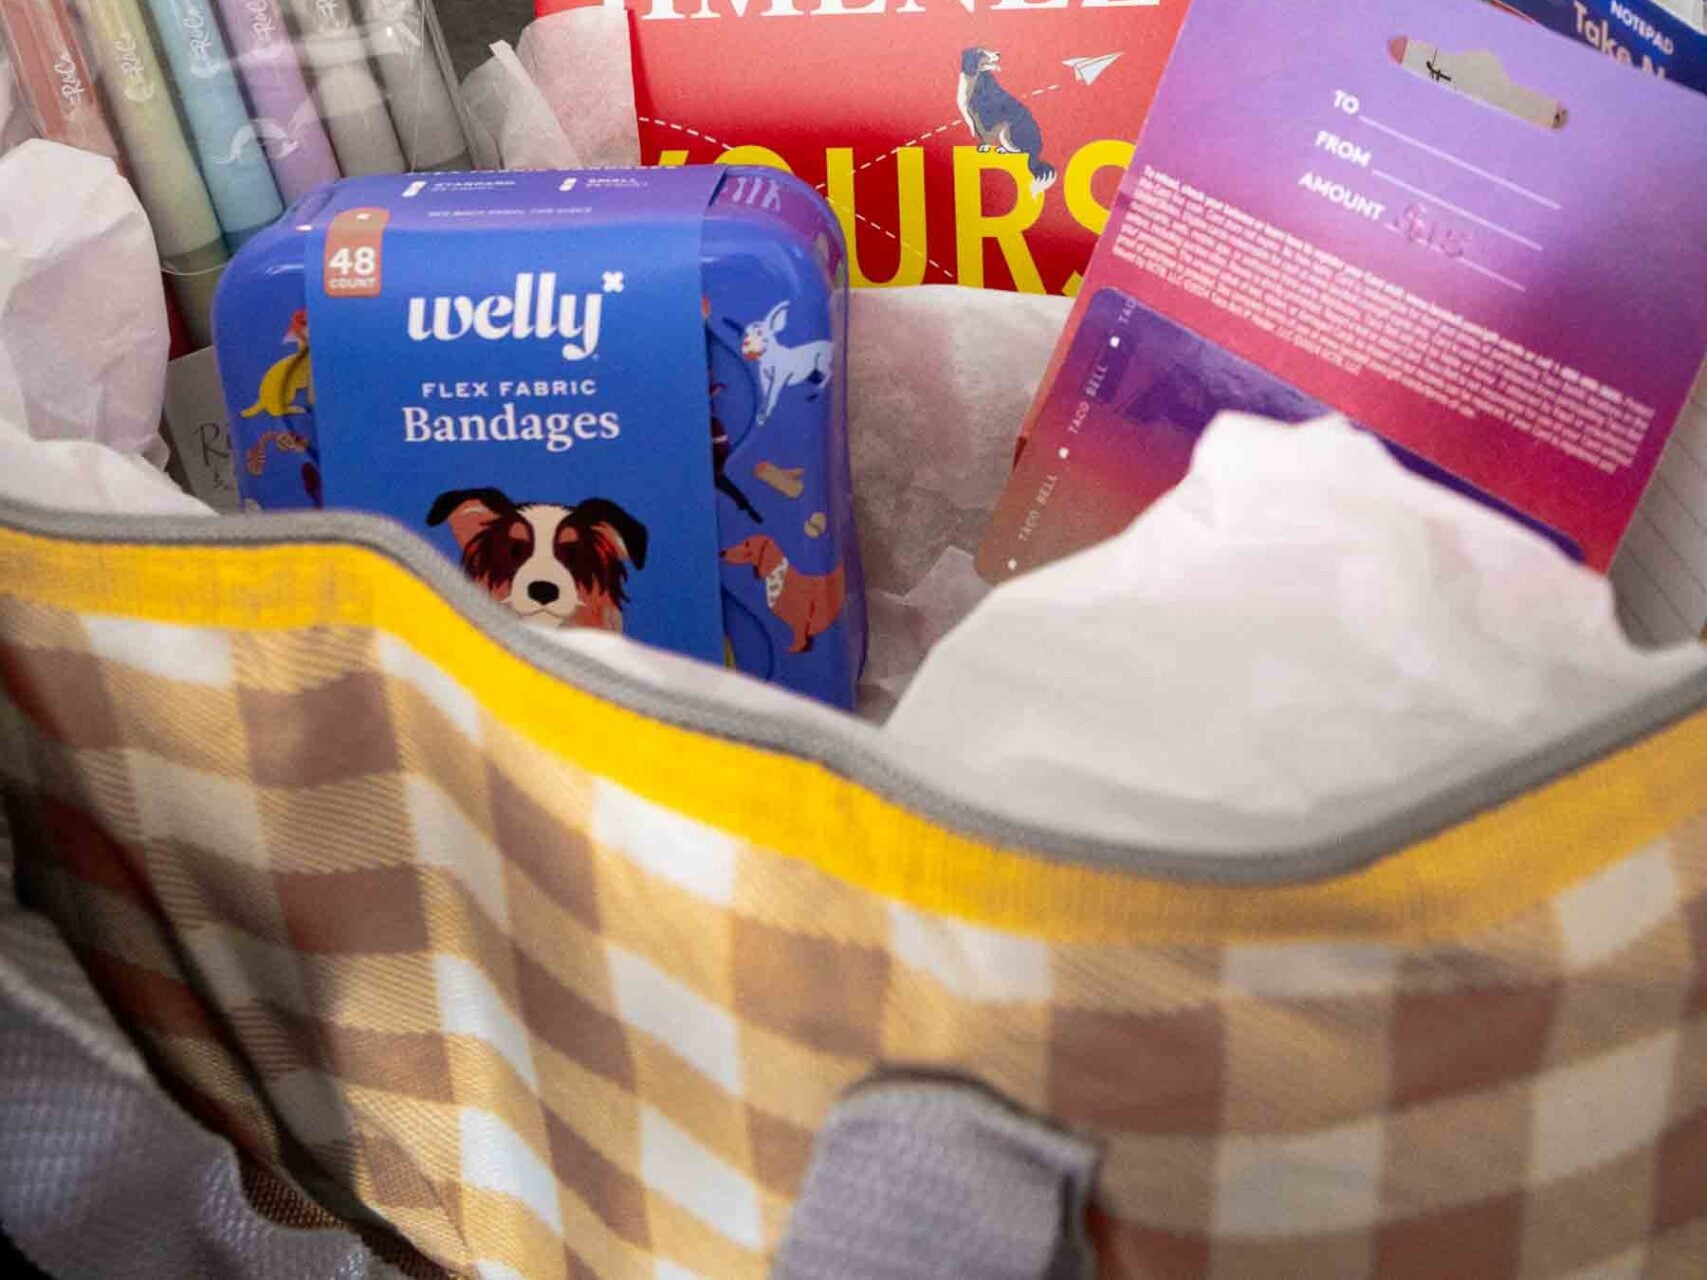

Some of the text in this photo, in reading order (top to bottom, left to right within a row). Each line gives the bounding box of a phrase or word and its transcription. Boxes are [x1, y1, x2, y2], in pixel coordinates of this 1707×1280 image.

[1610, 0, 1674, 55] NOTEPAD
[1333, 89, 1360, 115] TO
[1314, 130, 1372, 167] FROM
[1298, 172, 1386, 220] AMOUNT
[328, 246, 376, 275] 48
[408, 272, 603, 361] welly
[421, 379, 597, 398] FLEX FABRIC
[1067, 364, 1108, 435] TACO BELL
[402, 402, 620, 452] Bandages
